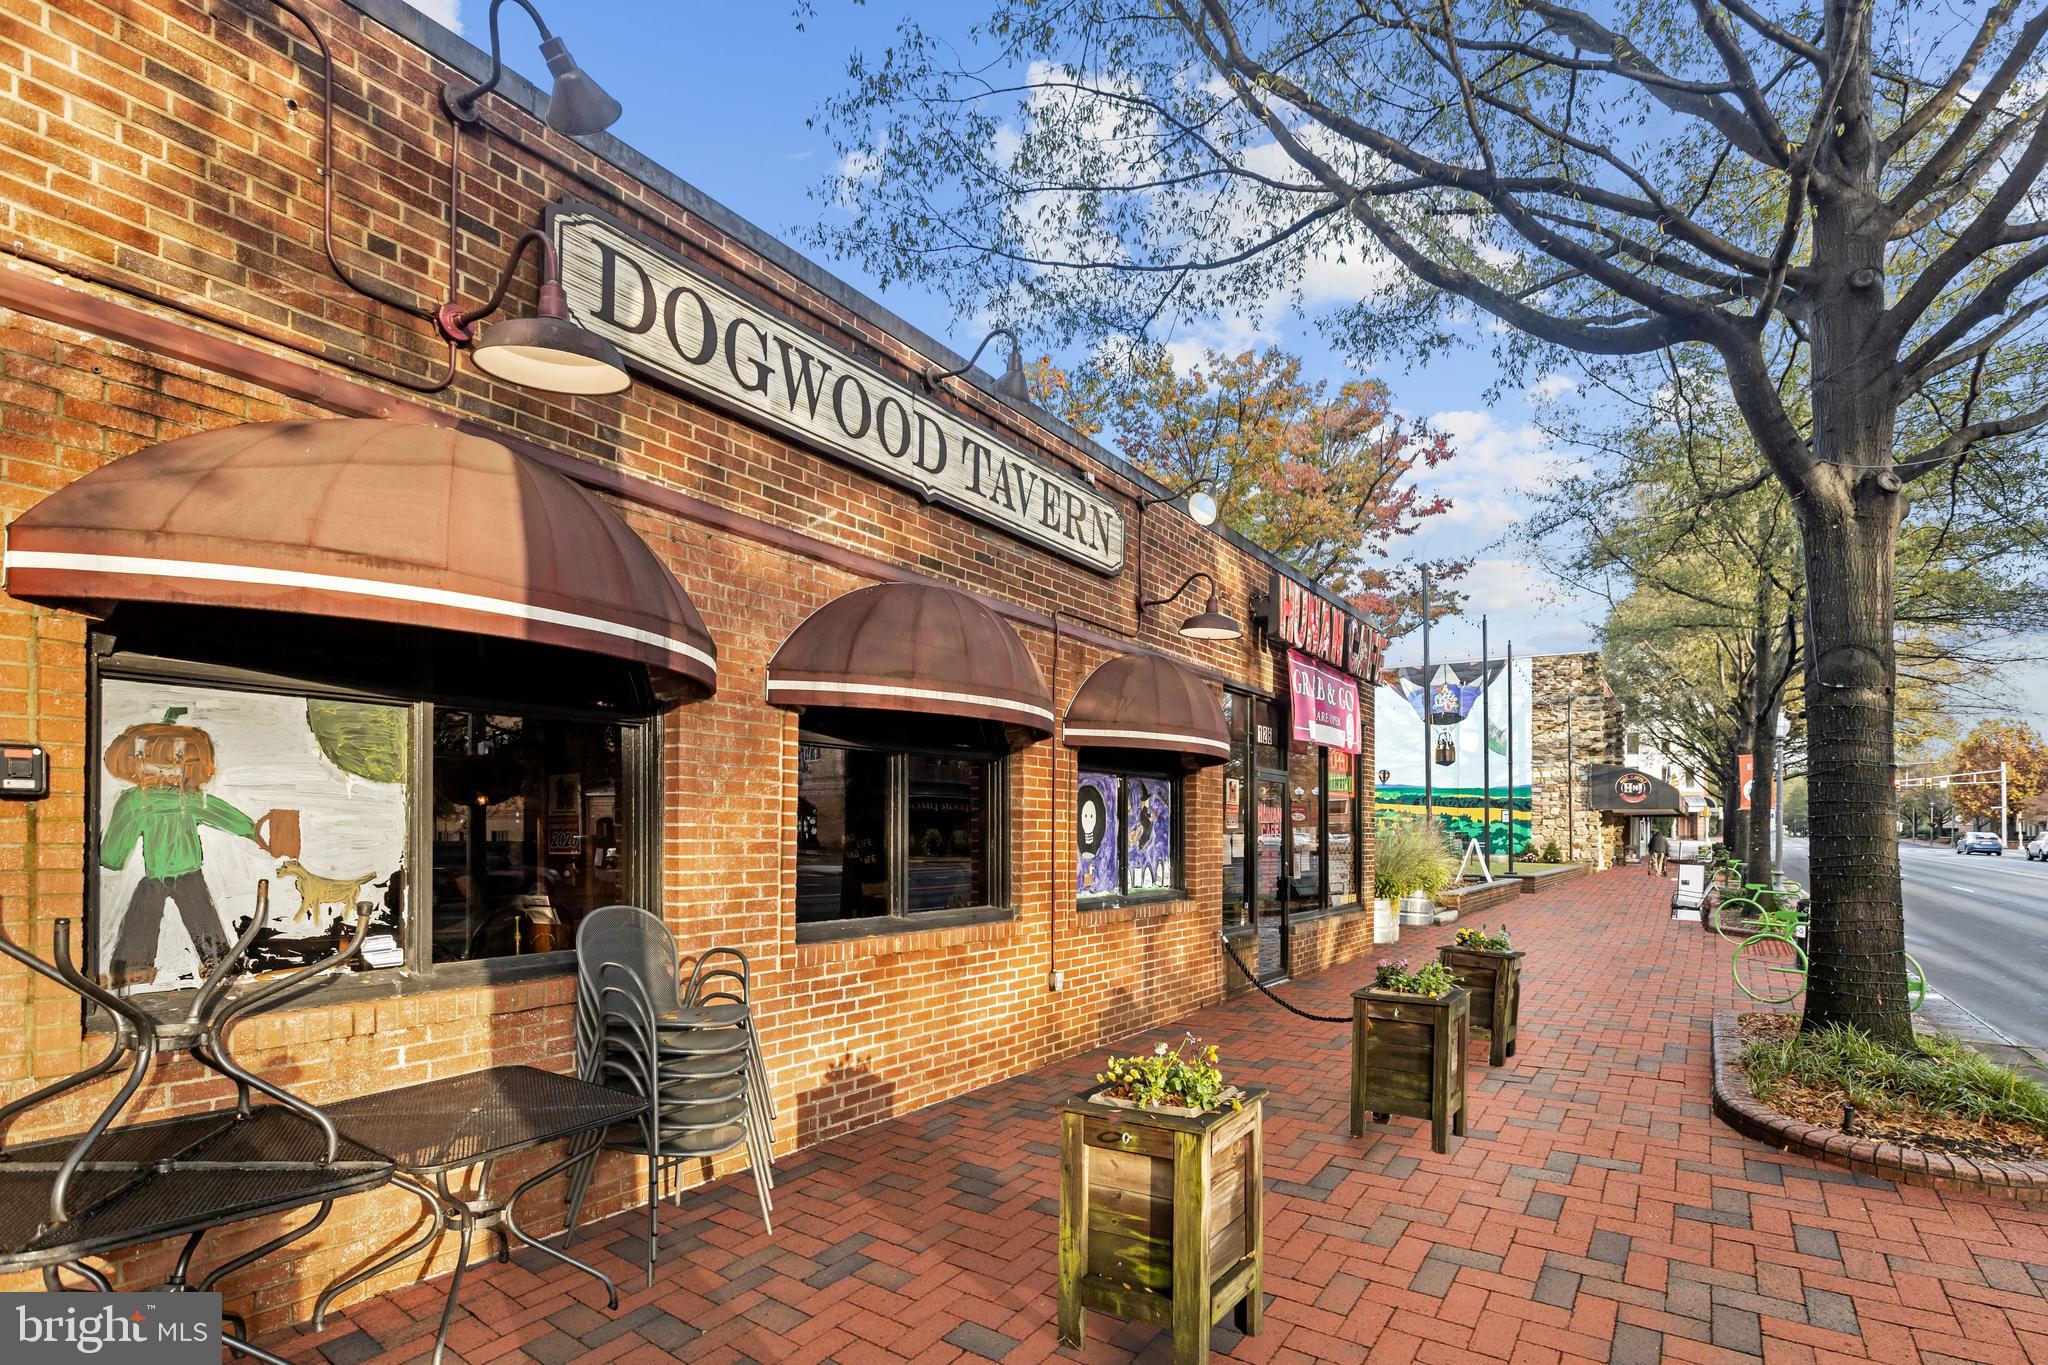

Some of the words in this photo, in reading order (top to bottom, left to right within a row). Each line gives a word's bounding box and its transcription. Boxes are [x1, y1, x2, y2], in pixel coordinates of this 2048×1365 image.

[590, 237, 947, 474] DOGWOOD
[962, 436, 1113, 557] TAVERN
[1280, 574, 1345, 667] HUNAN
[1348, 618, 1388, 684] CAFE
[1328, 683, 1337, 706] &
[1339, 687, 1354, 712] GO
[551, 830, 579, 849] 2020
